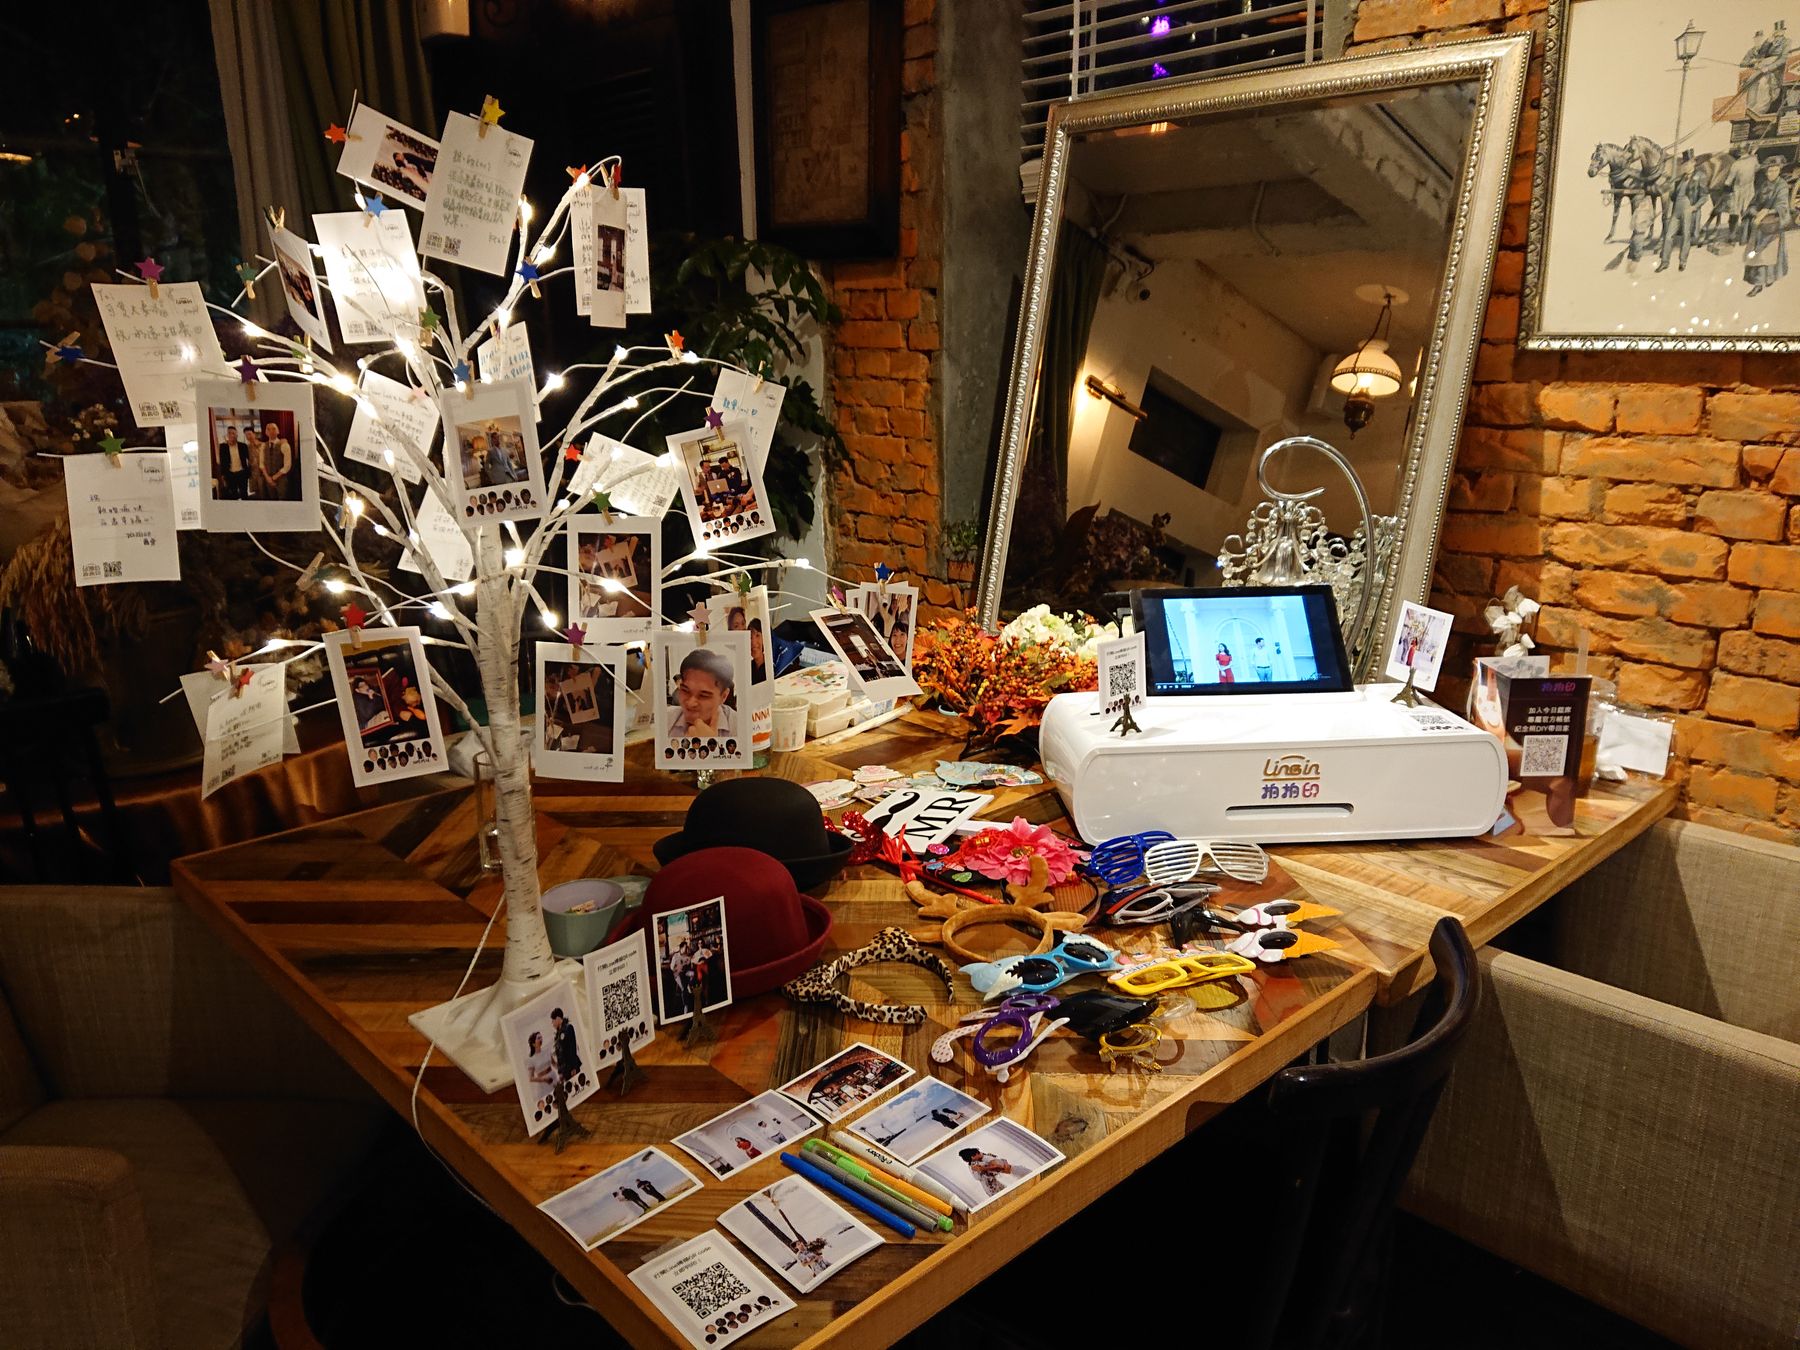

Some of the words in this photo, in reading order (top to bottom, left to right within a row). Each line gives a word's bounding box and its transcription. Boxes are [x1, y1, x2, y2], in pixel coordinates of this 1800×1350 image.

[1261, 781, 1320, 799] 拍拍印
[894, 795, 982, 841] MR
